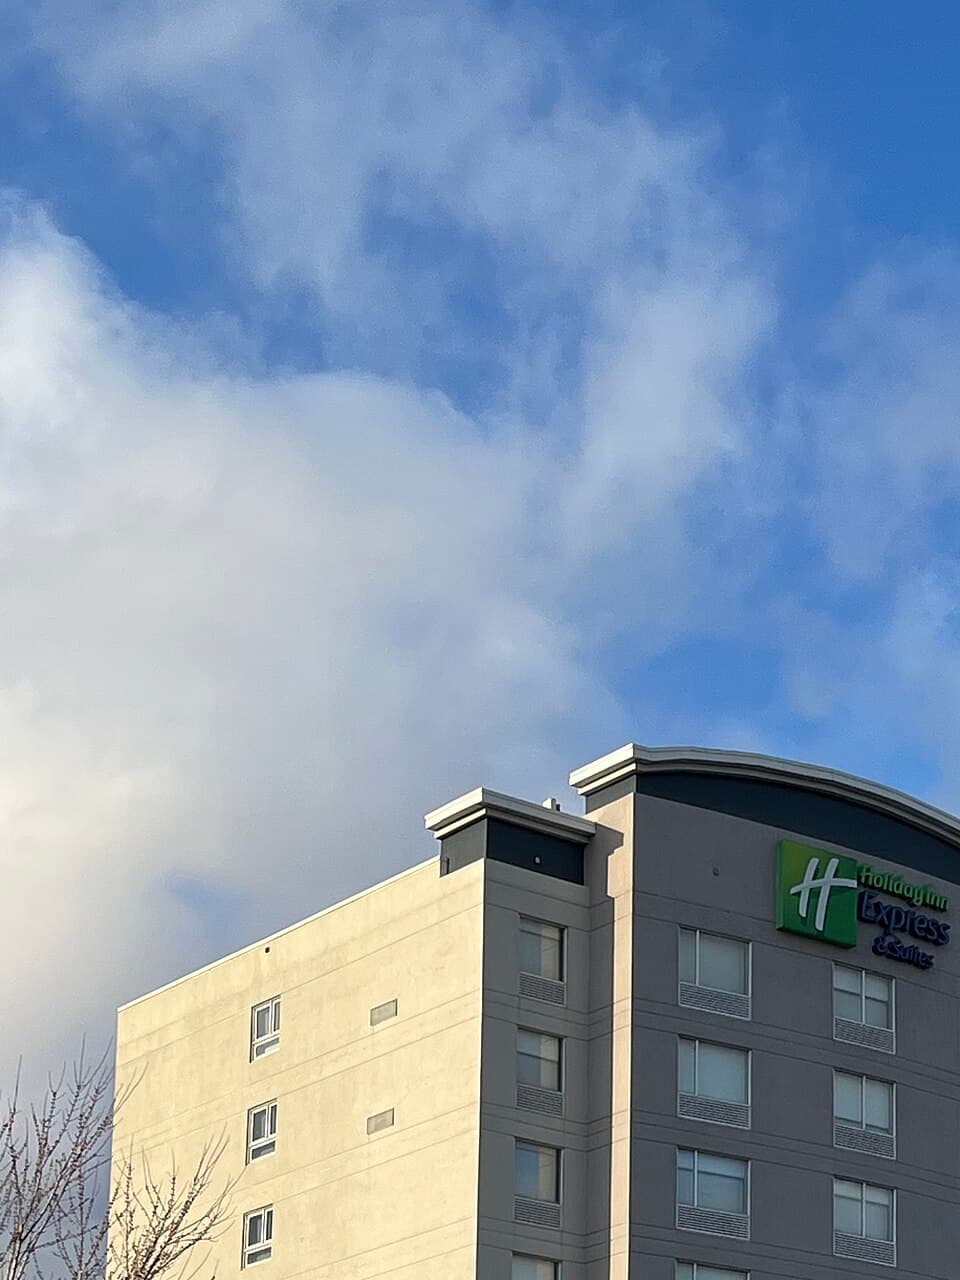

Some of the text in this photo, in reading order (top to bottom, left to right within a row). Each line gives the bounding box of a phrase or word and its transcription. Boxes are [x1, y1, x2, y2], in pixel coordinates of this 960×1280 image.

[858, 864, 951, 911] Holiday Inn
[857, 890, 952, 945] Express
